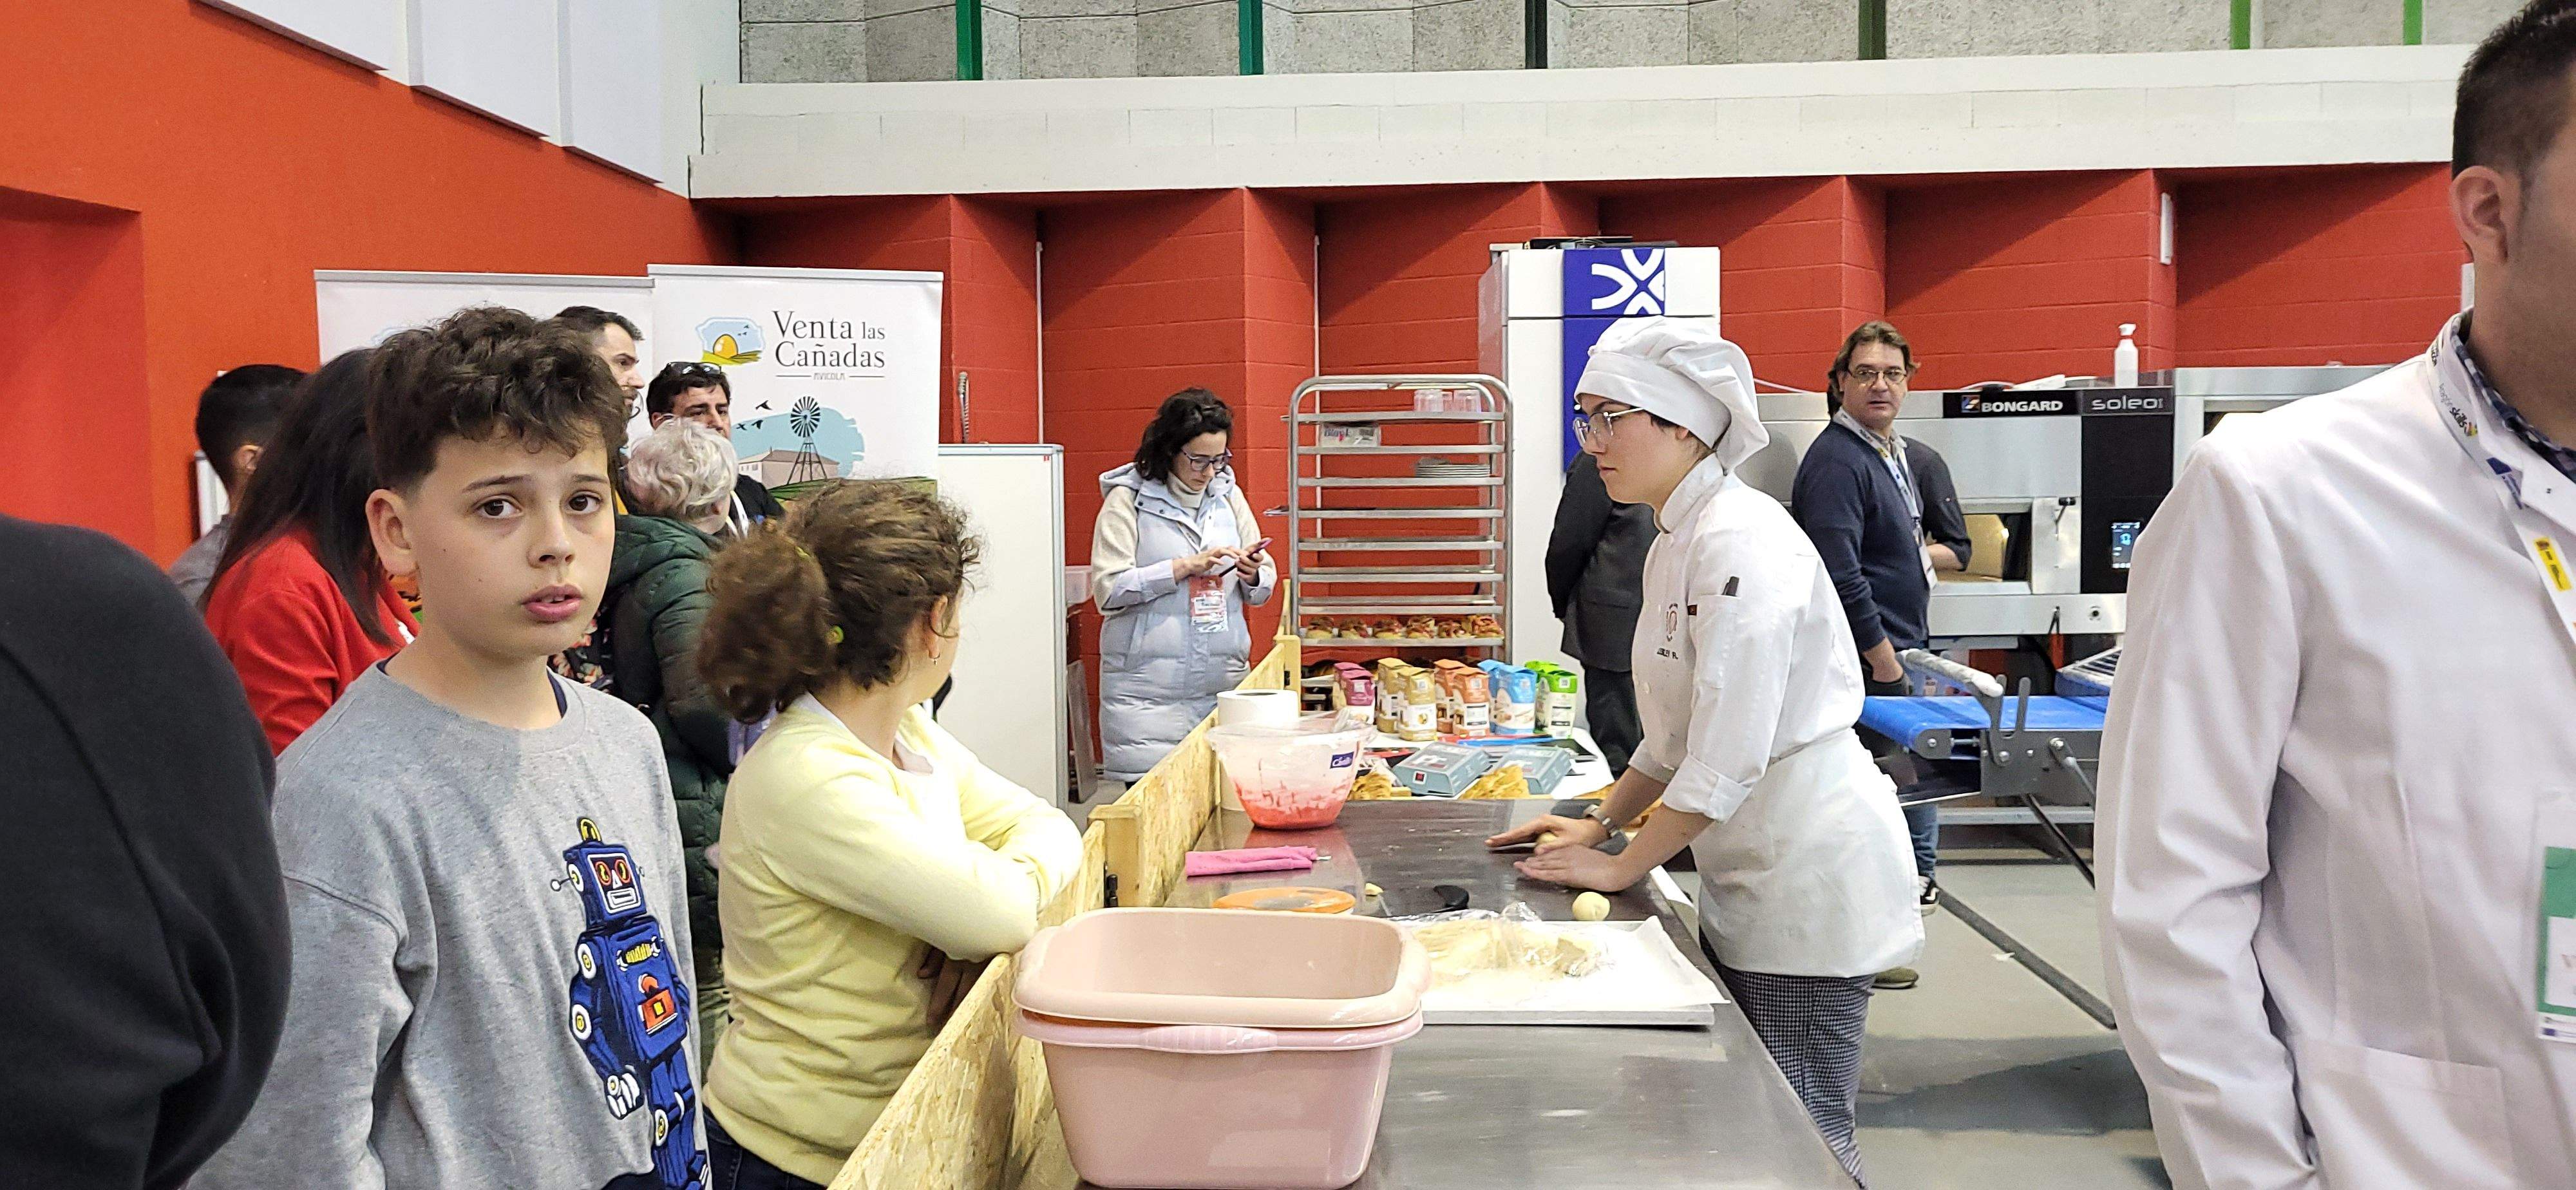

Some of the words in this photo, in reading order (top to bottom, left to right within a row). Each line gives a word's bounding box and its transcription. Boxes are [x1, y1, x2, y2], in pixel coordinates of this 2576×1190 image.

[772, 310, 853, 339] Venta
[862, 321, 886, 339] las
[775, 341, 885, 368] Cañadas
[1981, 401, 2063, 412] BONGARD
